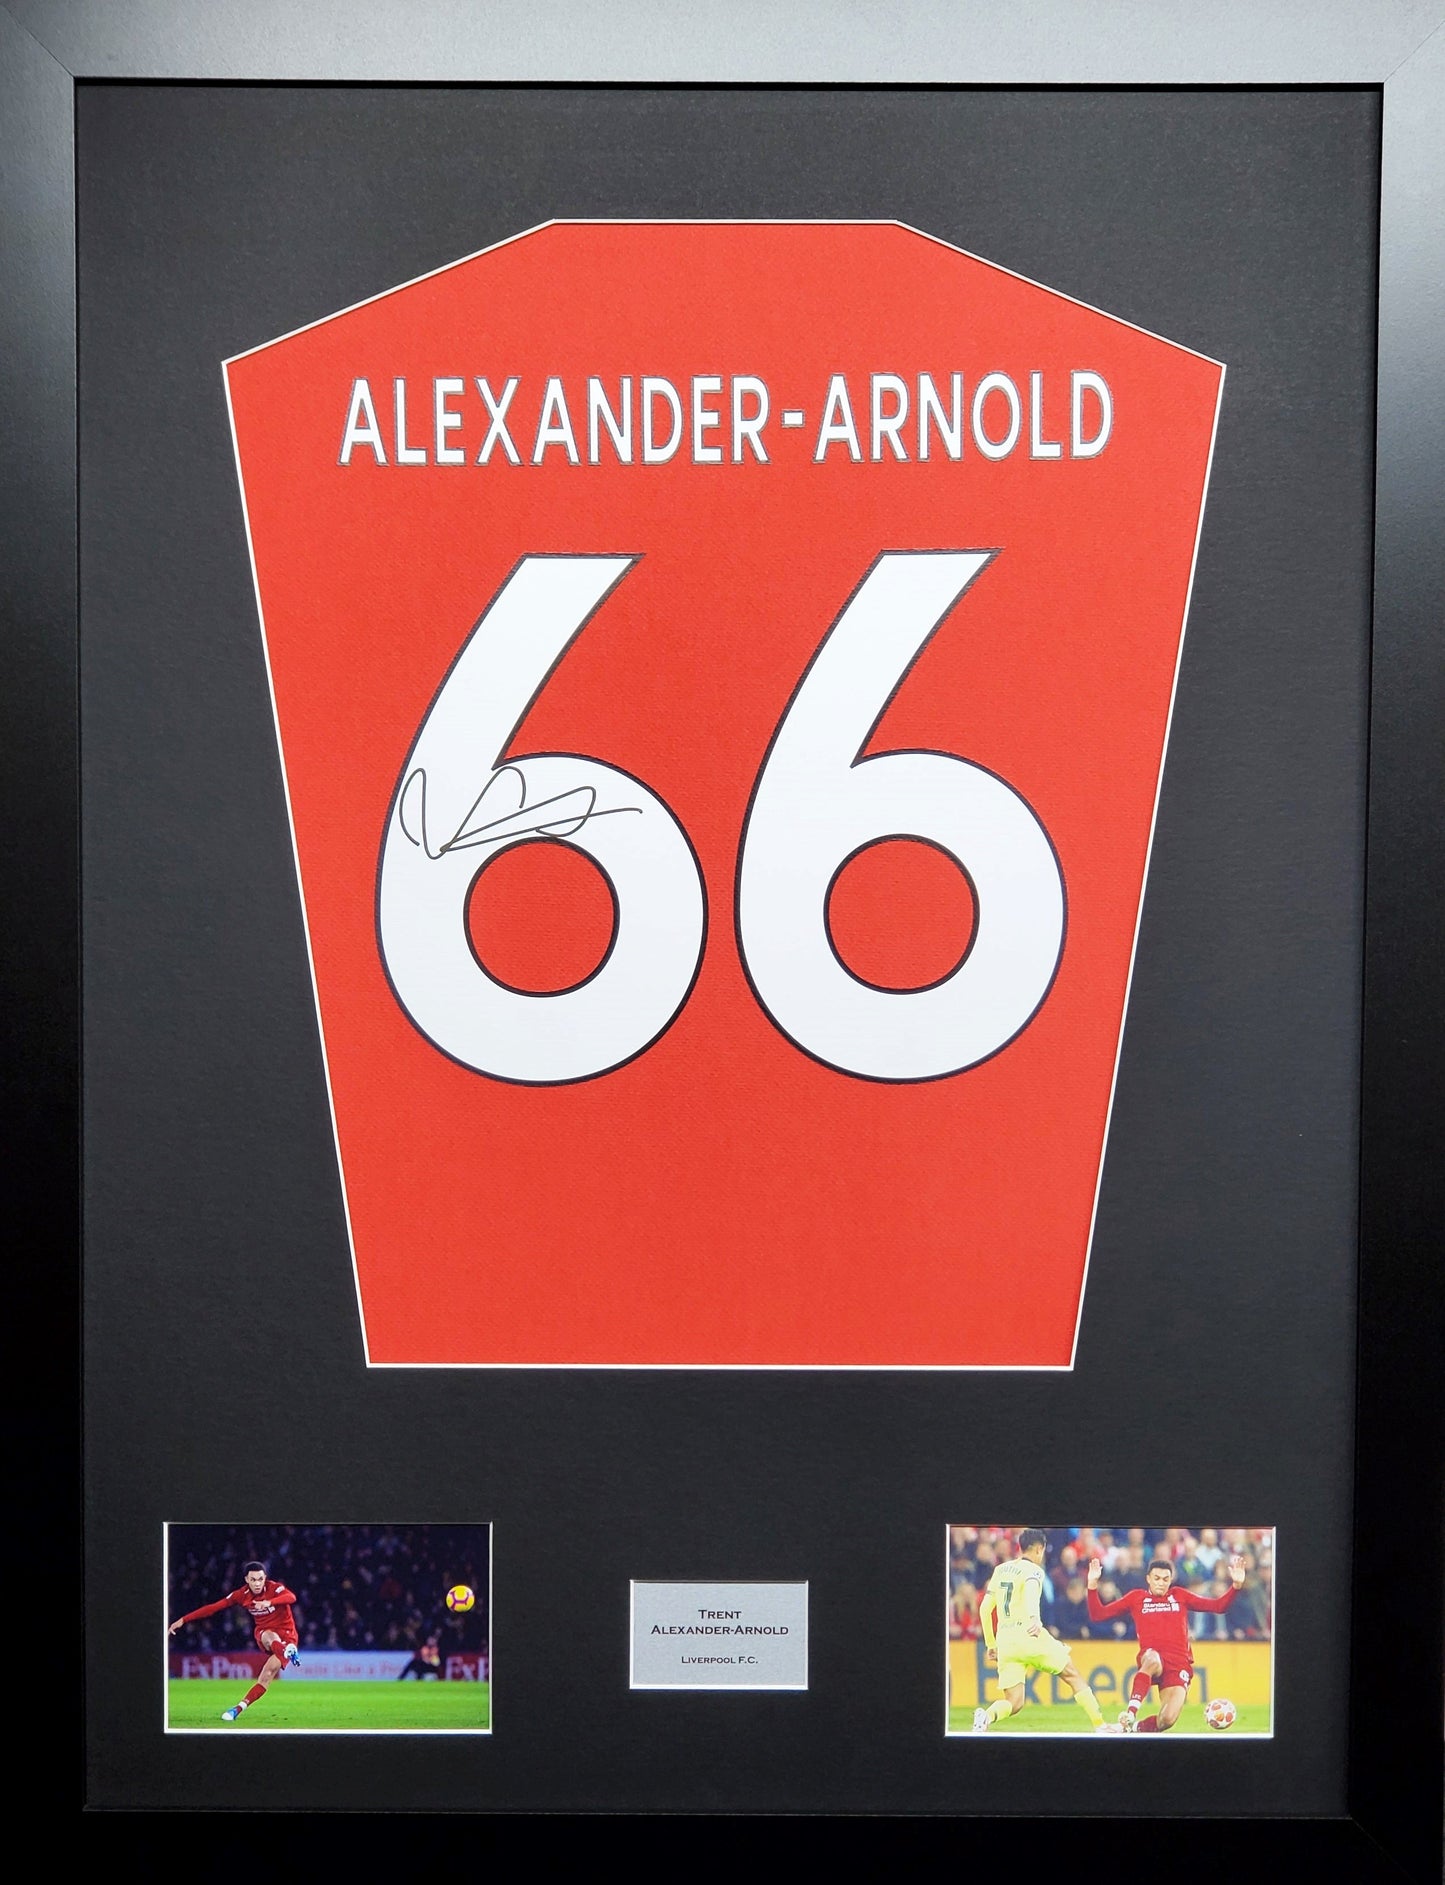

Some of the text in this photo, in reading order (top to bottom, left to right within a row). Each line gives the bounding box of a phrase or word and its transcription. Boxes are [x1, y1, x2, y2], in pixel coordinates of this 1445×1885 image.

[336, 368, 1115, 467] ALEXANDER-ARNOLD
[374, 547, 1069, 1087] 66
[1000, 1581, 1013, 1617] 7
[738, 1656, 759, 1664] F.C.
